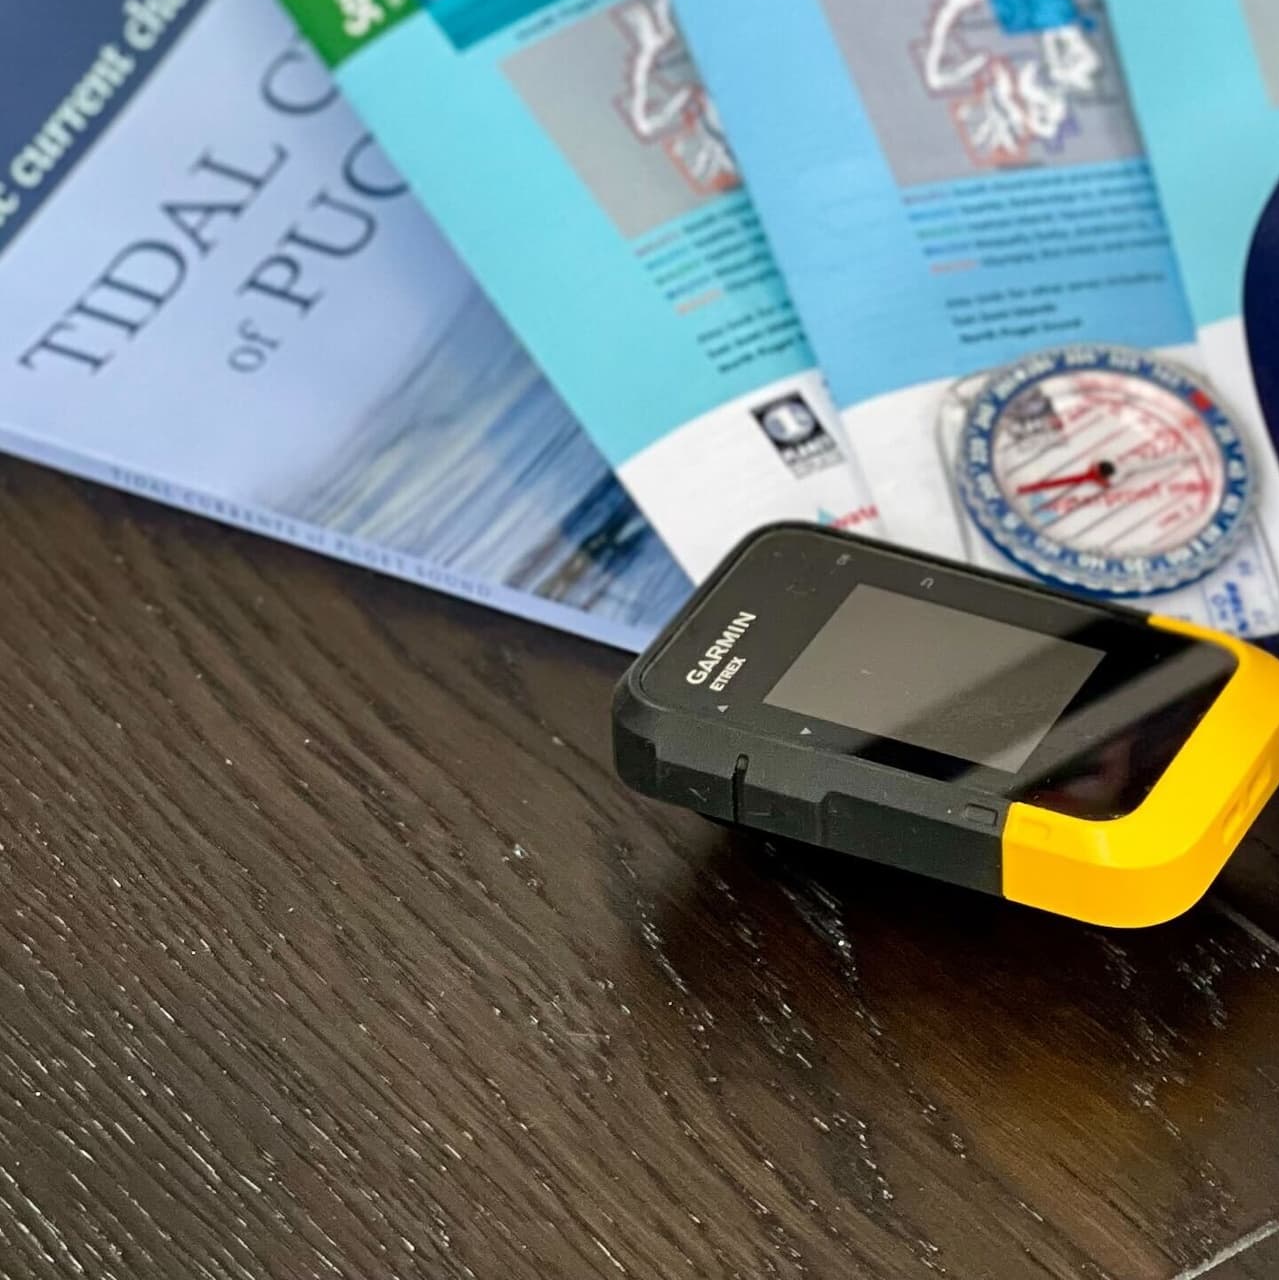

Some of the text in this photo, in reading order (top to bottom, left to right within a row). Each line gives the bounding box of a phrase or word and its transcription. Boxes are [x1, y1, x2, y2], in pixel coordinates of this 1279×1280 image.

[9, 42, 136, 189] current
[16, 140, 291, 376] TIDAL
[227, 317, 281, 374] of
[685, 610, 757, 685] GARMIN
[708, 656, 747, 692] ETREX
